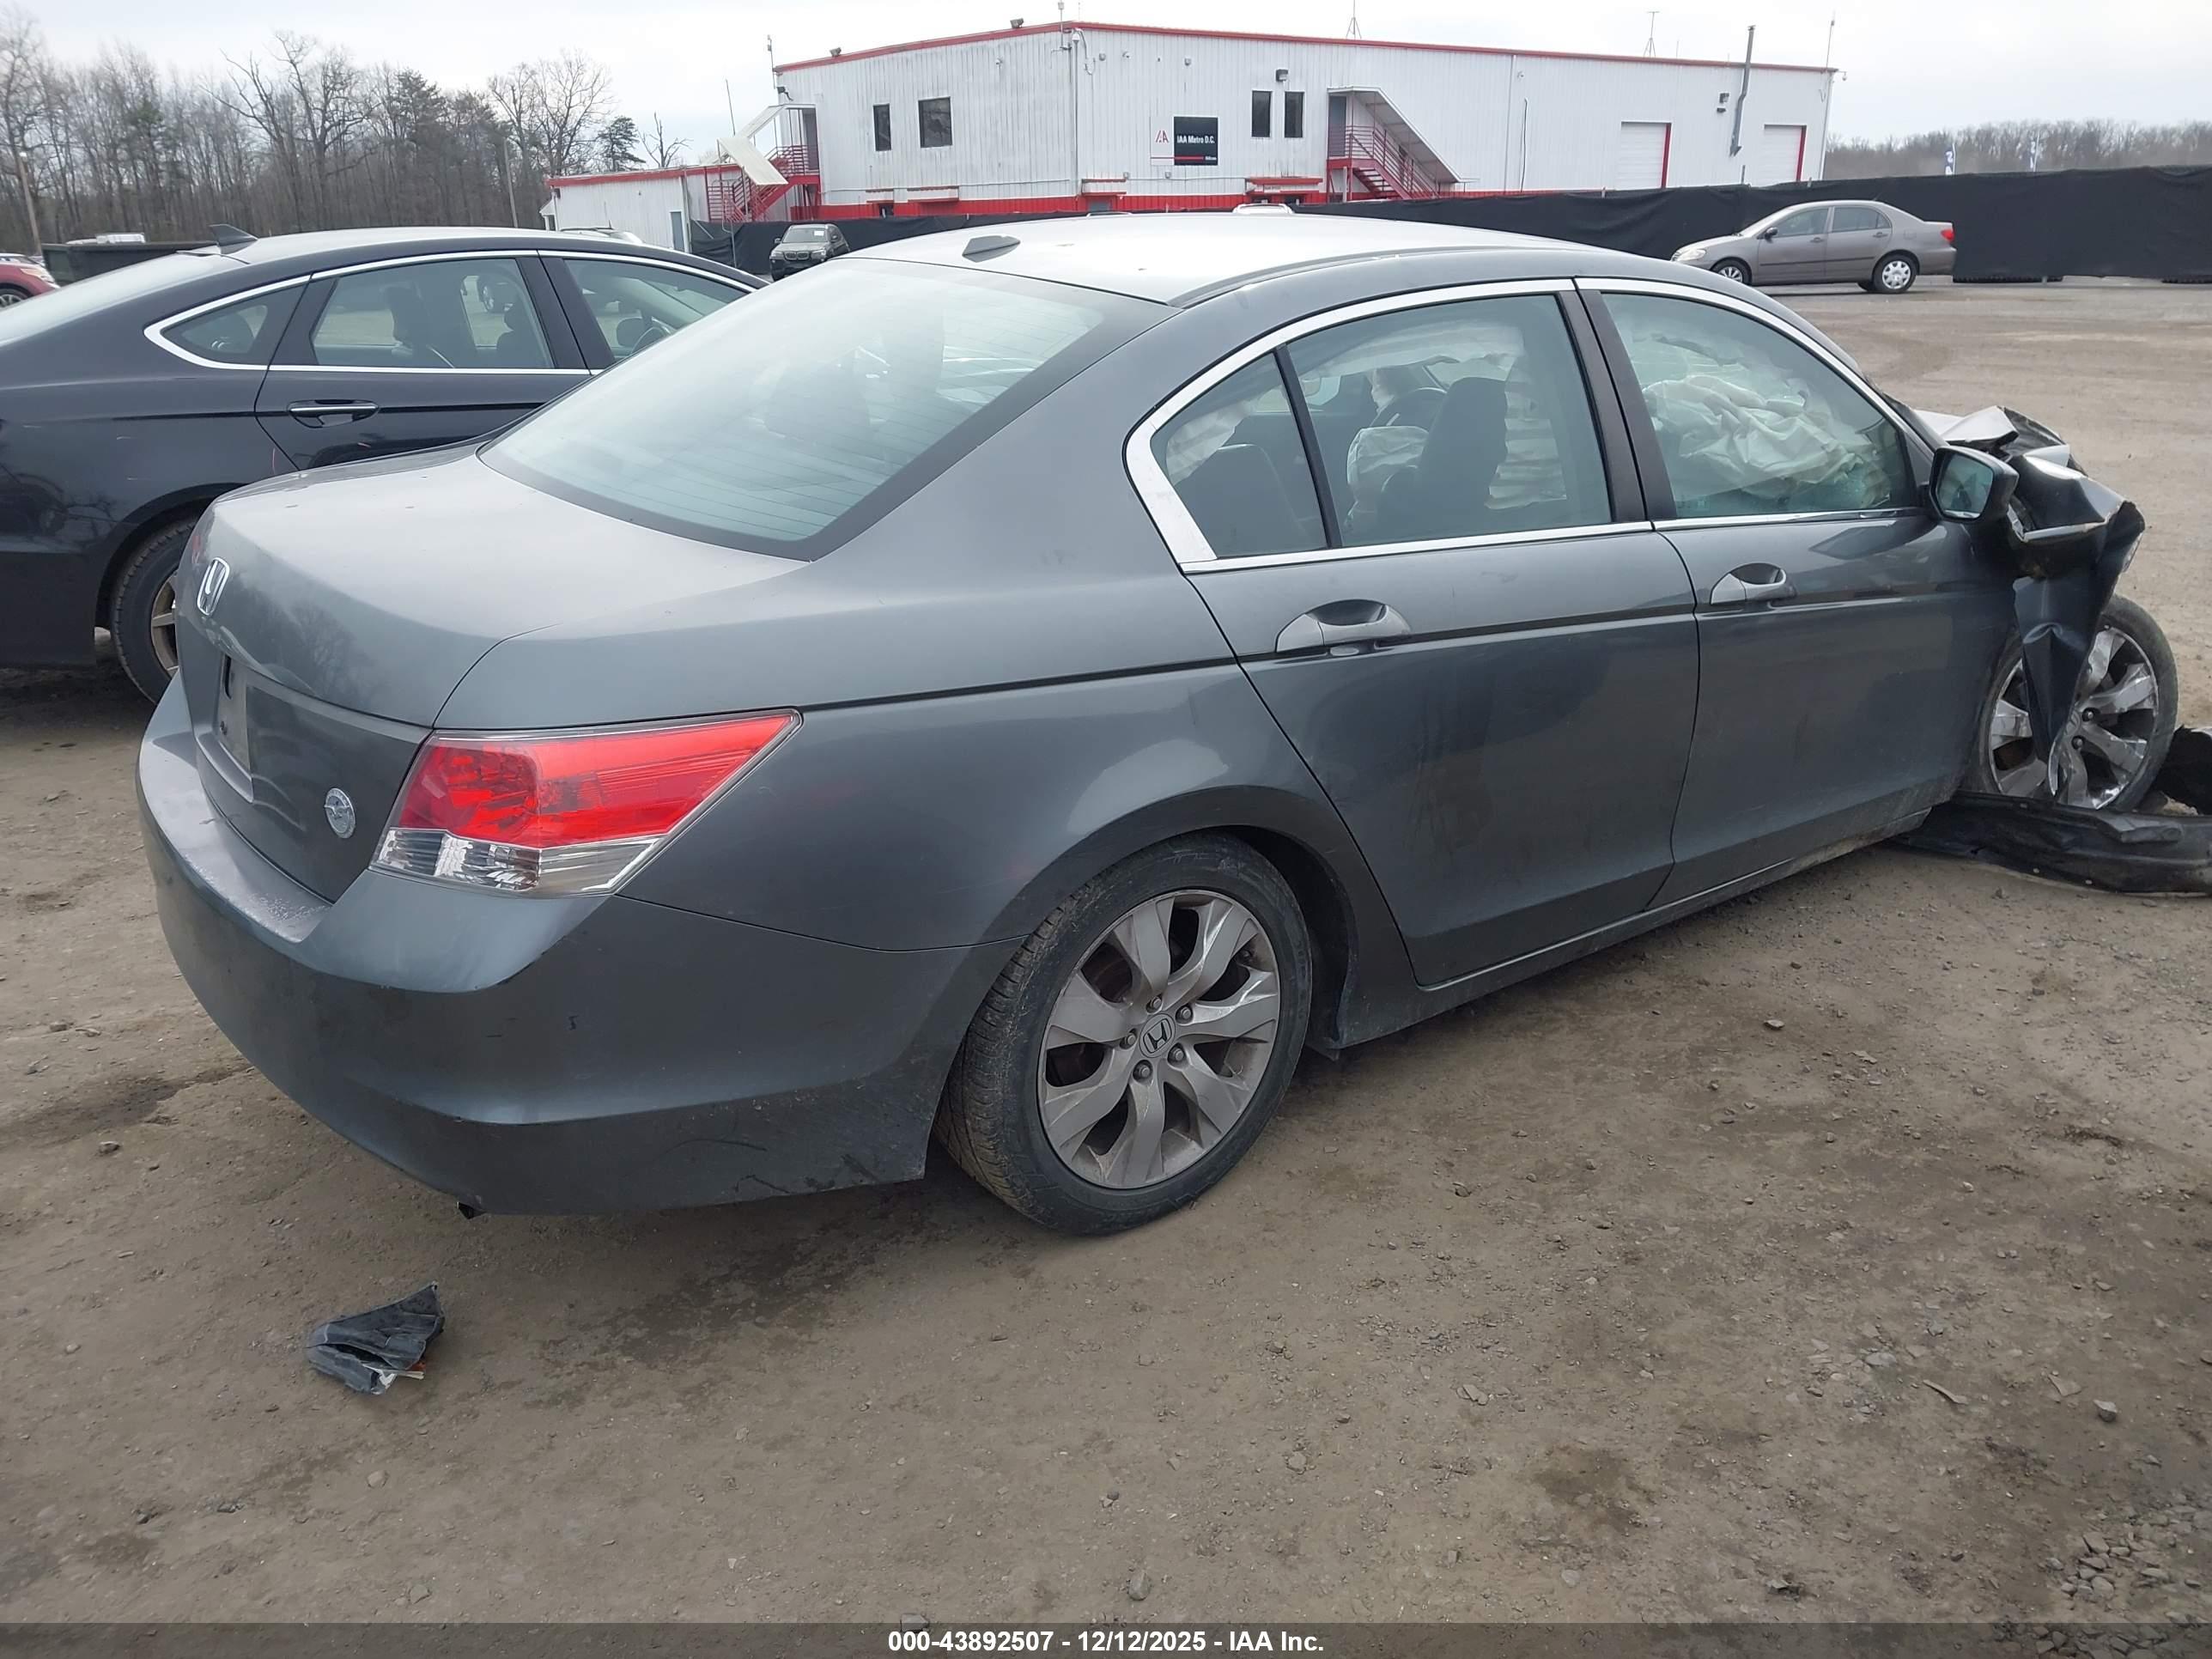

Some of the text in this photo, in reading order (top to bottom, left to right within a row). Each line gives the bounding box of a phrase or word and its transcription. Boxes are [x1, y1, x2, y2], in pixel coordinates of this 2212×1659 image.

[1176, 135, 1215, 144] IAA Metro D.C.
